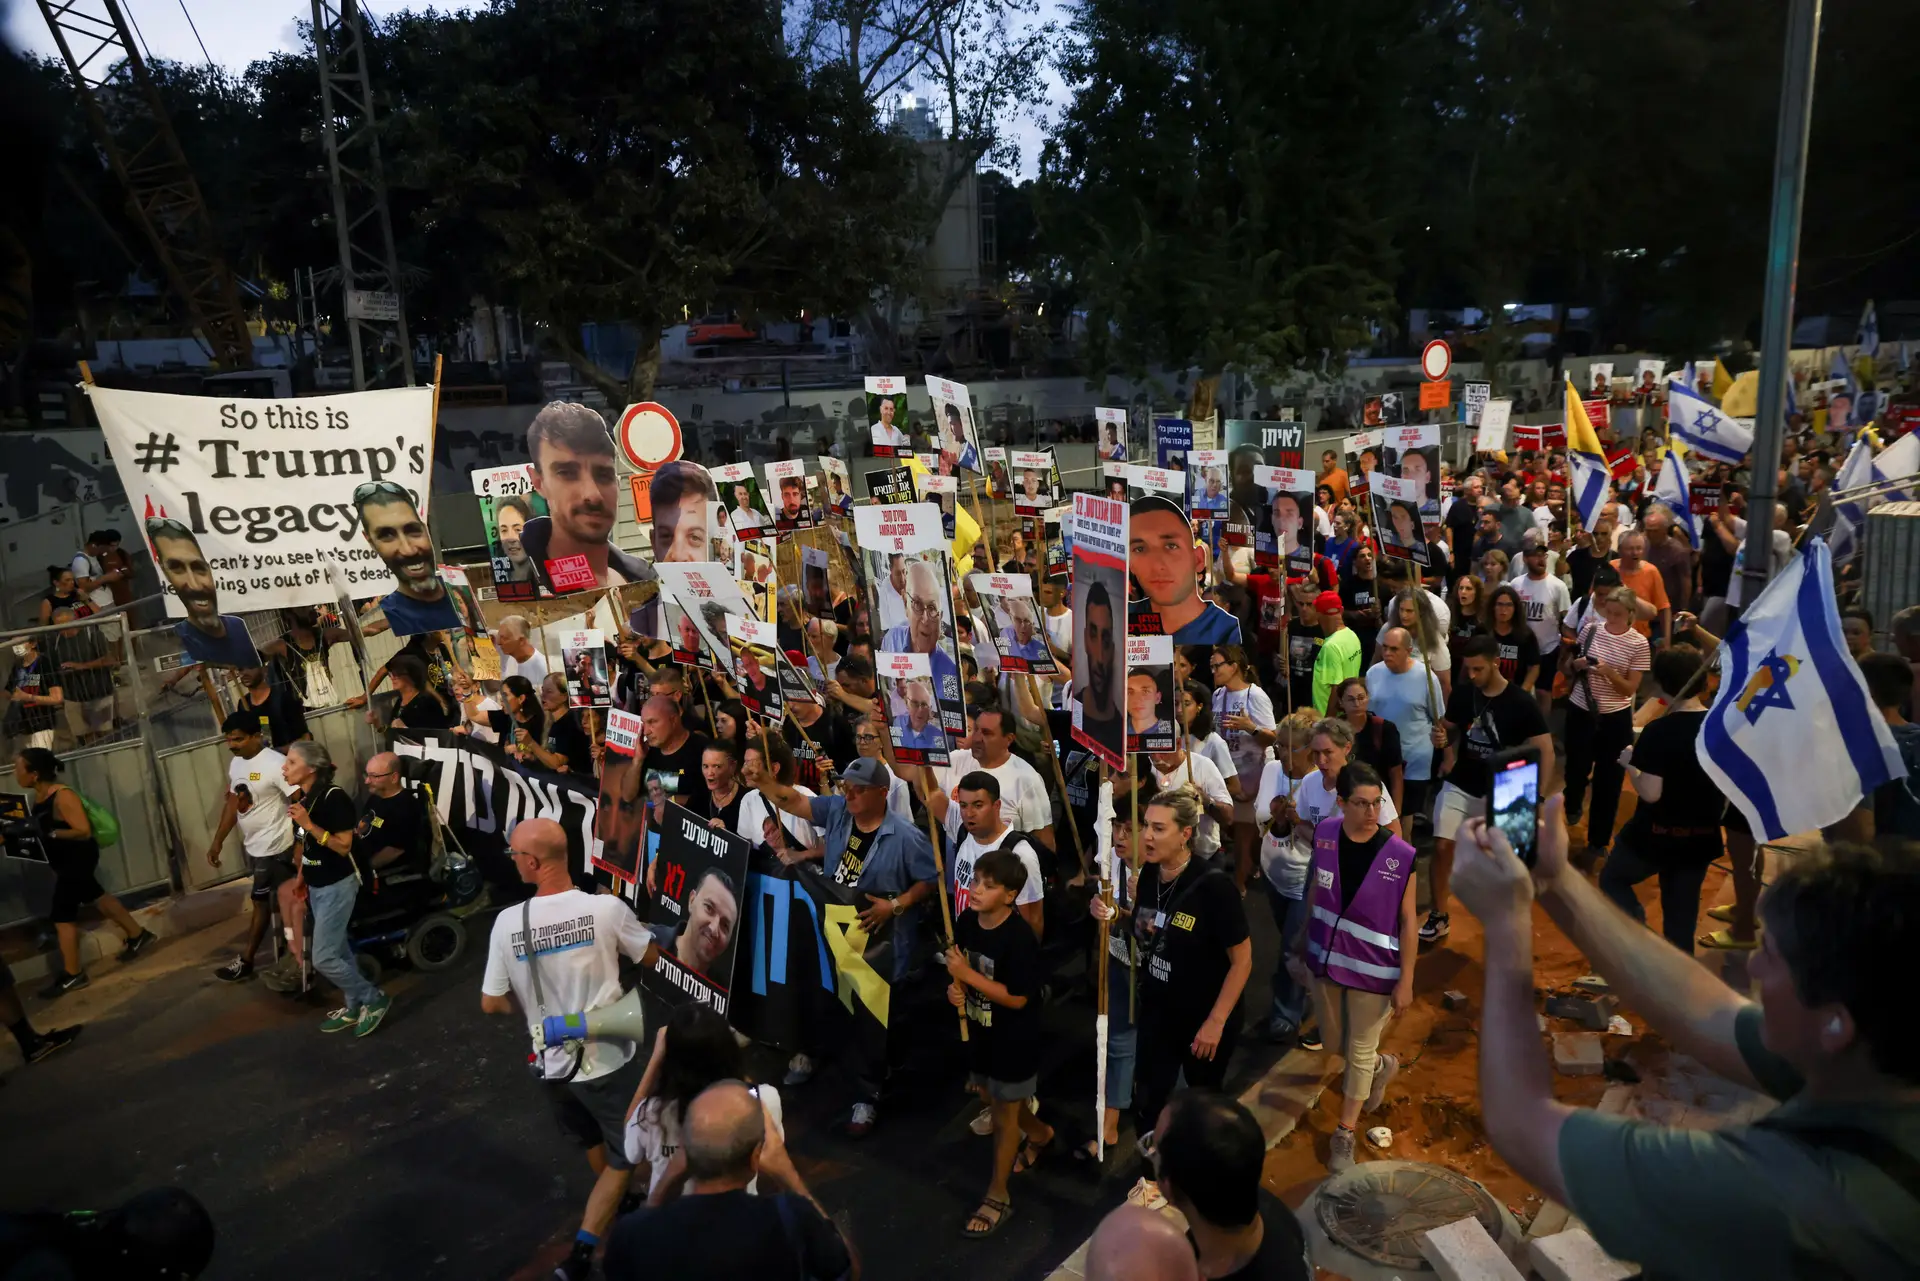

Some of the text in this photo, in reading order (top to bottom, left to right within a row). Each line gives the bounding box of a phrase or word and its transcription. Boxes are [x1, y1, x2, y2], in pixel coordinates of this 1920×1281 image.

[220, 403, 350, 430] So this is
[1261, 426, 1302, 449] לאיתן
[197, 434, 425, 482] Trump's
[879, 524, 915, 536] AMIRAM COOPER
[210, 552, 250, 571] can't
[253, 552, 286, 570] you
[288, 550, 314, 564] see
[556, 556, 586, 571] עדיין
[250, 575, 271, 590] us
[273, 573, 303, 588] out
[304, 569, 321, 585] of
[1138, 615, 1160, 625] מתן
[610, 713, 618, 727] 22
[682, 818, 708, 849] שרעבי
[710, 833, 728, 858] יוסי
[663, 861, 687, 900] לא
[539, 919, 576, 938] המשפחות
[577, 915, 594, 927] מטה
[1173, 912, 1194, 929] 690
[555, 927, 595, 948] החטופים
[682, 972, 711, 1004] שכולם
[713, 990, 726, 1015] עד
